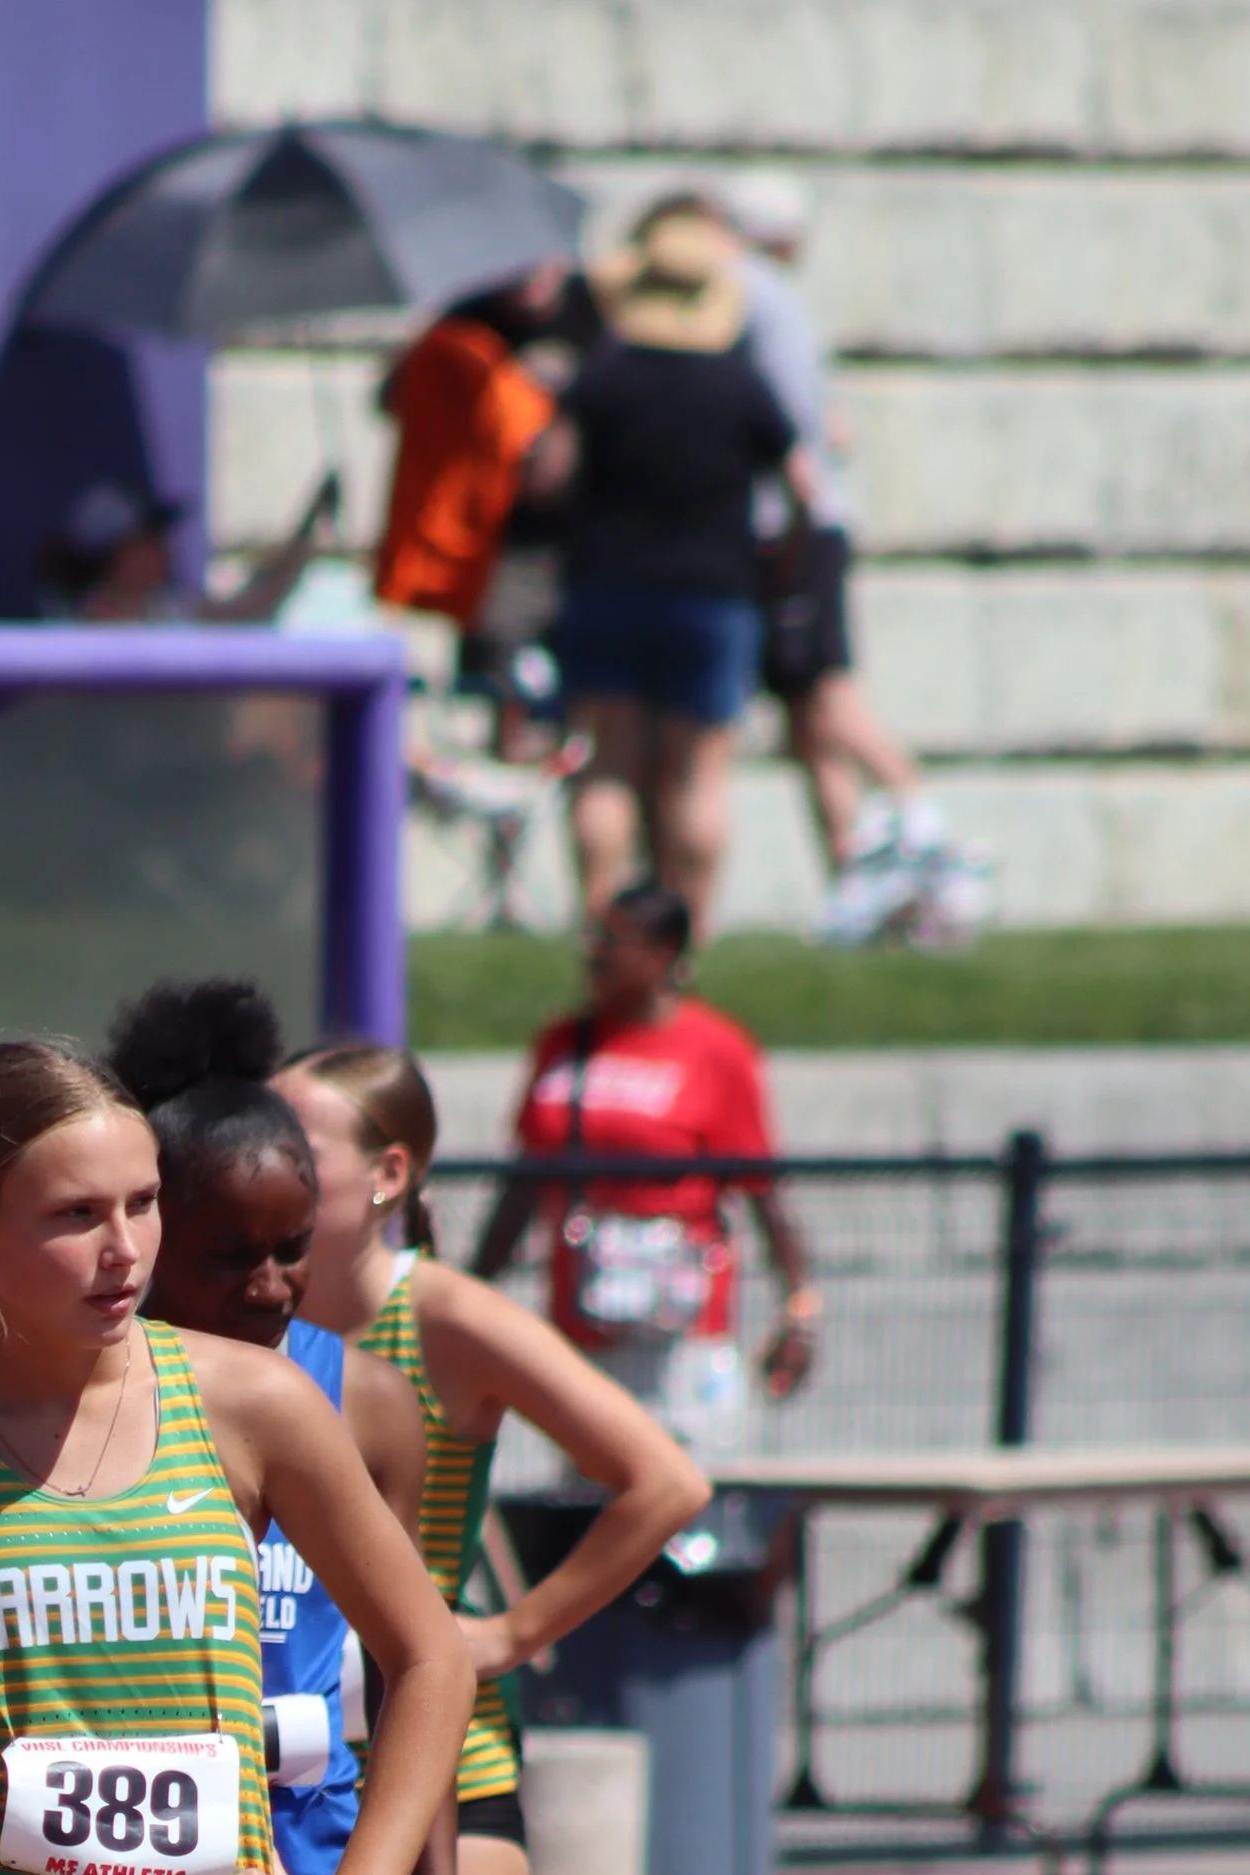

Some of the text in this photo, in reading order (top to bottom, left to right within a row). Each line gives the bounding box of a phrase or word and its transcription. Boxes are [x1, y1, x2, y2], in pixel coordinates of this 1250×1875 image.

[21, 1739, 217, 1758] VHSL CHAMPIONSHIPS
[42, 1760, 199, 1857] 389
